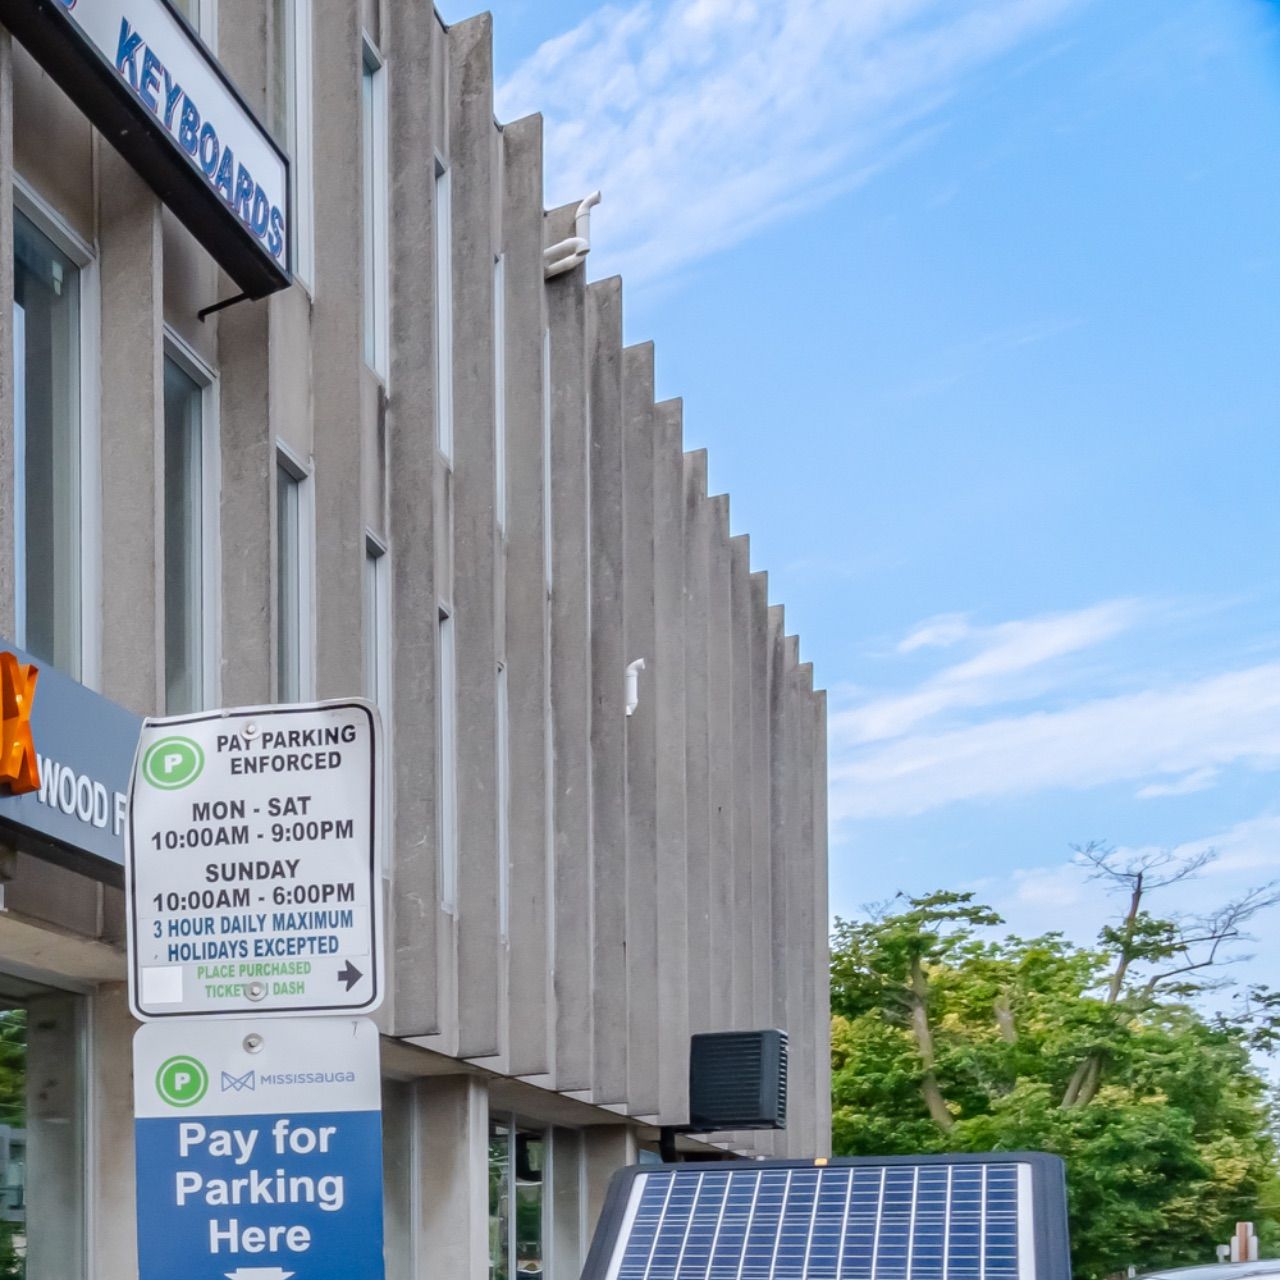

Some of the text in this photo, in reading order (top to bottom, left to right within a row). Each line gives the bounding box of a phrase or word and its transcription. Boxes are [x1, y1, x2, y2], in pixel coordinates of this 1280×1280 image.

[115, 16, 285, 258] KEYBOARDS
[217, 725, 356, 752] PAY PARKING
[231, 751, 342, 775] ENFORCED
[37, 753, 108, 828] WOOD
[192, 800, 246, 822] MON
[268, 796, 311, 817] SAT
[151, 825, 249, 850] 10:00AM
[271, 820, 354, 843] 9:00PM
[205, 859, 301, 882] SUNDAY
[153, 888, 250, 912] 10:00AM
[273, 883, 355, 905] 6:00PM
[153, 910, 354, 938] 3 HOUR DAILY MAXIMUM
[168, 935, 339, 962] HOLIDAYS EXCEPTED
[197, 961, 311, 979] PLACE PURCHASED
[273, 981, 305, 995] DASH
[179, 1119, 336, 1165] Pay for
[176, 1168, 344, 1211] Parking
[209, 1219, 311, 1253] Here
